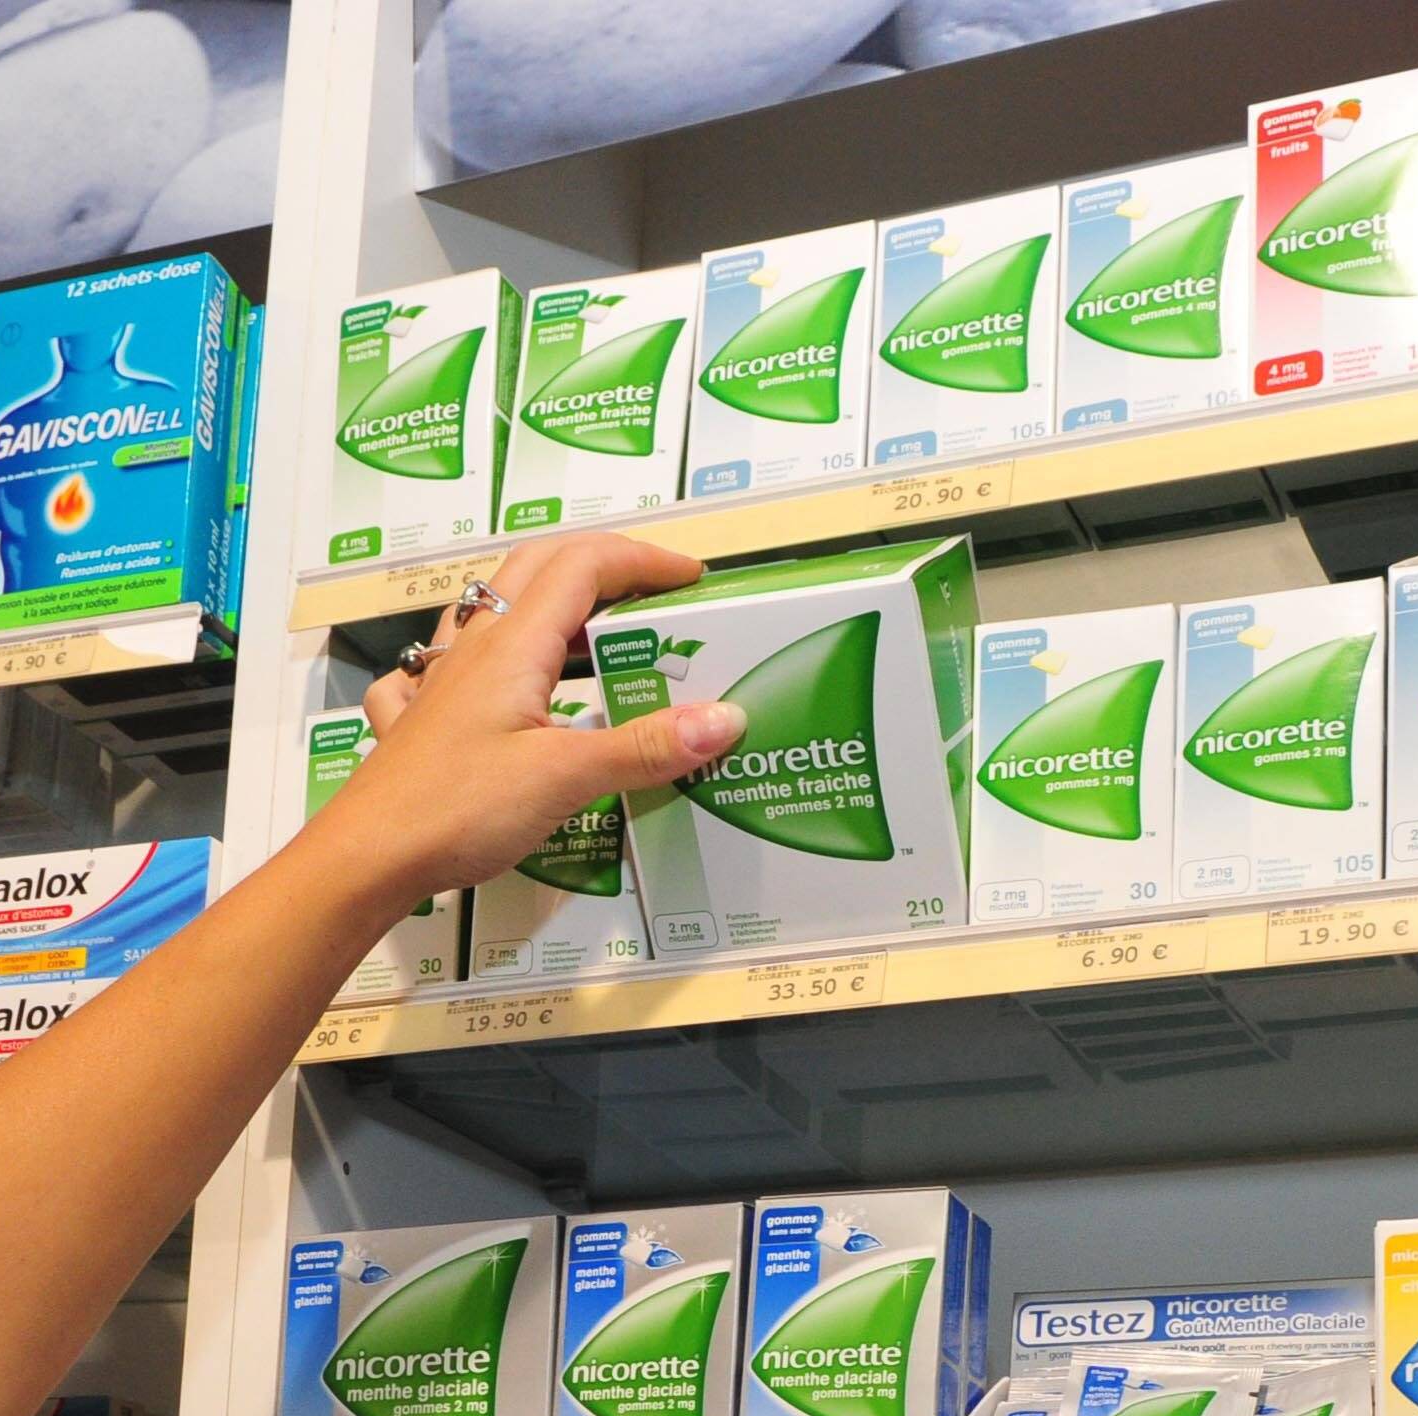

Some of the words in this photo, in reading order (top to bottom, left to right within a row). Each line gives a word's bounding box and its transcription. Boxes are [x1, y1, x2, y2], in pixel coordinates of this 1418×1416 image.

[1270, 140, 1309, 159] fruits
[67, 280, 86, 299] 12
[90, 259, 202, 297] sachets-dose
[1076, 274, 1216, 321] nicorette
[890, 311, 1024, 354] nicorette
[345, 399, 460, 440] nicorette
[358, 432, 407, 453] menthe
[411, 420, 459, 442] fraîche
[894, 485, 963, 510] 20.90
[977, 483, 991, 498] €
[452, 519, 473, 534] 30
[602, 638, 653, 656] gommes
[4, 654, 49, 673] 4.90
[53, 651, 66, 667] €
[989, 746, 1134, 781] nicorette
[713, 781, 792, 806] menthe
[797, 769, 871, 798] fraîche
[906, 897, 944, 918] 210
[1298, 921, 1377, 946] 19.90
[1393, 918, 1410, 937] €
[768, 977, 837, 1001] 33.50
[849, 976, 864, 993] €
[1028, 1307, 1145, 1338] Testez
[336, 1348, 490, 1379] nicorette
[762, 1342, 901, 1370] nicorette
[346, 1380, 413, 1402] menthe
[419, 1378, 489, 1400] glaciale
